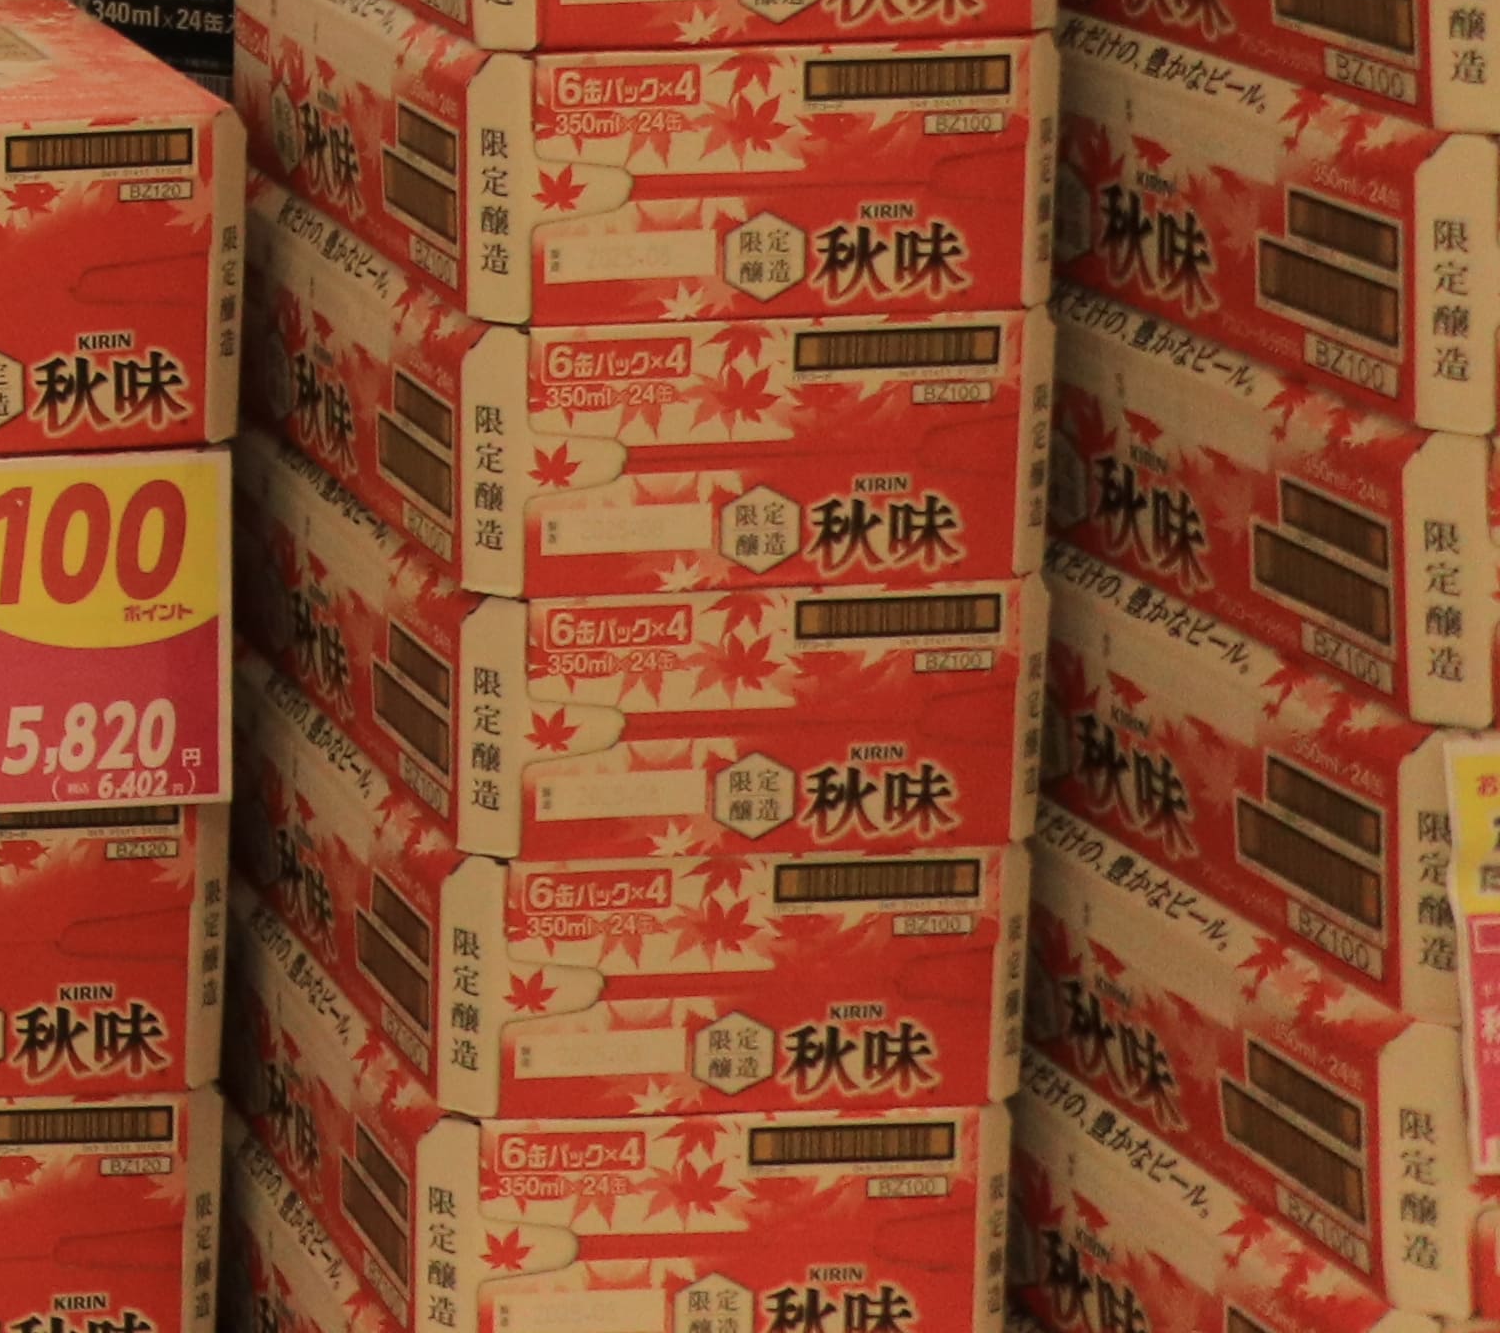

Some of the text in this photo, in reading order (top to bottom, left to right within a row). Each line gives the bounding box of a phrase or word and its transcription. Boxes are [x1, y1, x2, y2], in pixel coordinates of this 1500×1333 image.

[128, 182, 183, 200] BZ120
[811, 224, 968, 300] 秋味
[77, 332, 133, 352] KIRIN
[33, 354, 190, 435] 秋味
[122, 601, 194, 624] ポイント
[1, 696, 179, 780] 5,820
[97, 768, 168, 800] 6,402
